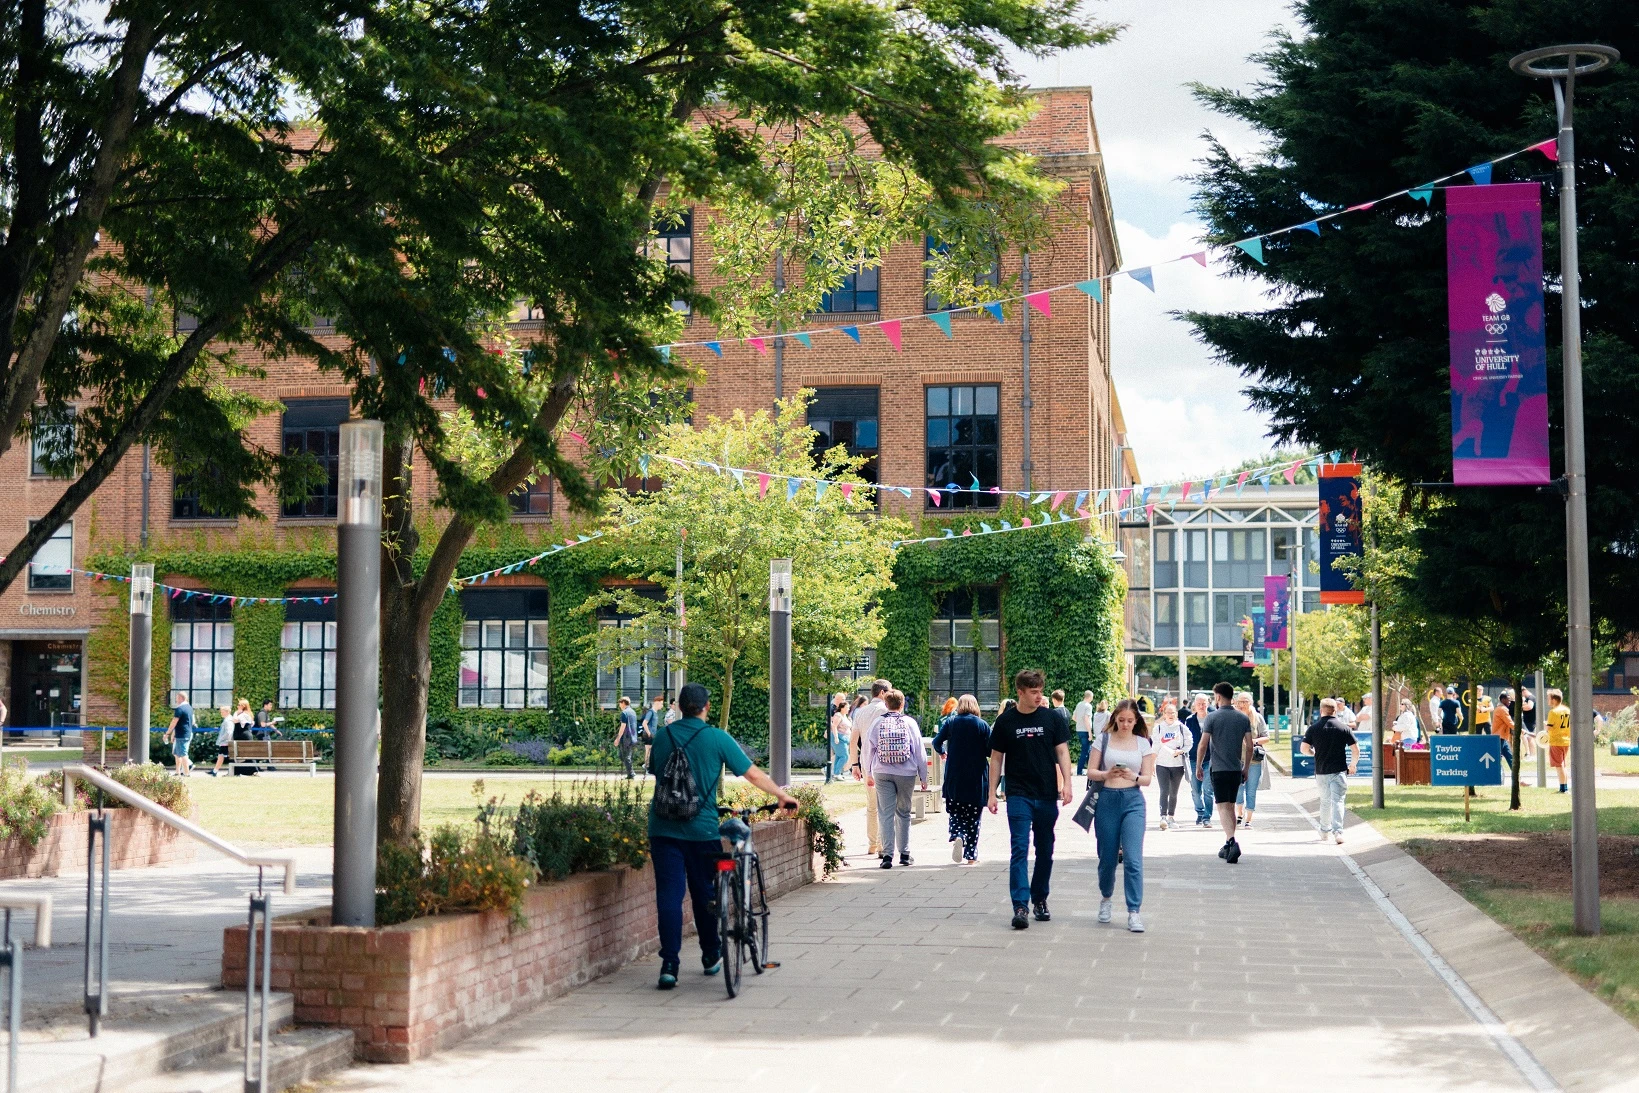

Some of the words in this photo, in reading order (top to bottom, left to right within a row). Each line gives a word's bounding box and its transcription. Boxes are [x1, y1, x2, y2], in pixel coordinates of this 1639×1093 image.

[1475, 355, 1519, 364] UNIVERSITY
[1475, 363, 1485, 371] OF
[1487, 363, 1507, 371] HULL
[19, 603, 77, 618] Chemistry
[1560, 714, 1571, 728] 27
[1015, 726, 1044, 735] SUPREME
[1435, 745, 1462, 753] Taylor
[1436, 769, 1468, 777] Parking
